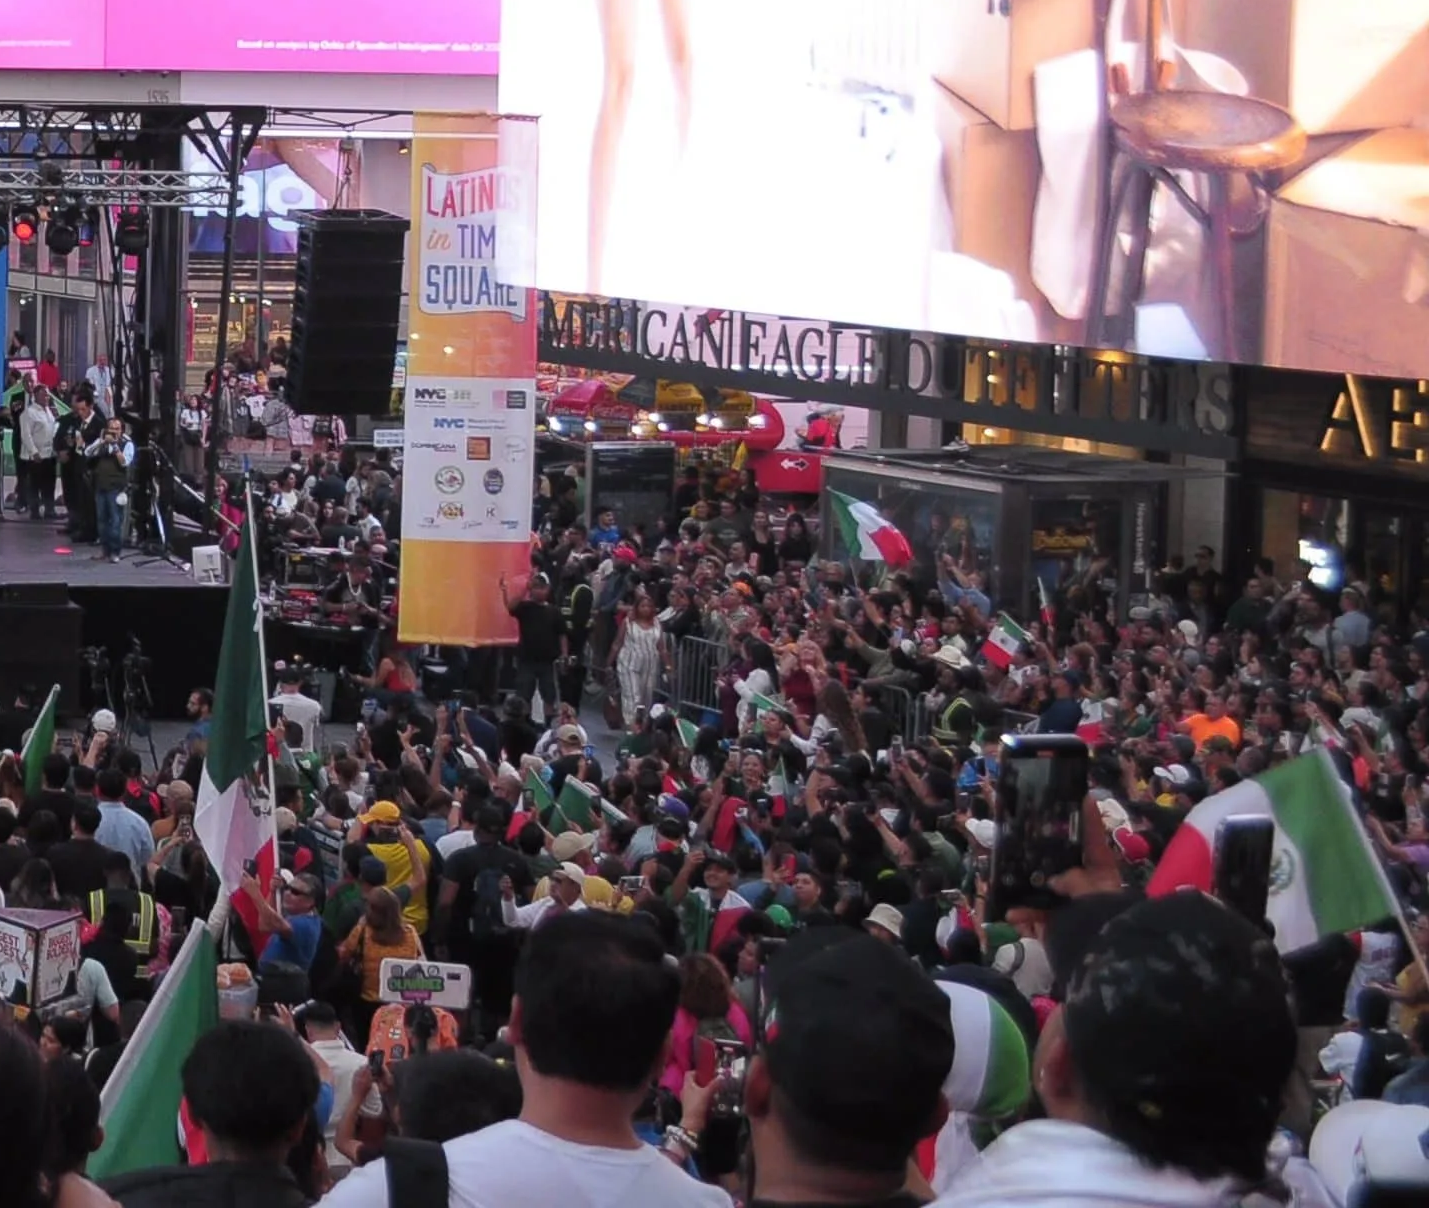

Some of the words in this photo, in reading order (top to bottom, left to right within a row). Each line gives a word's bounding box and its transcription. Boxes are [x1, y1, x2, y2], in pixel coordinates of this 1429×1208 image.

[426, 228, 452, 251] in
[457, 224, 497, 260] TIM
[541, 292, 734, 370] MERICAN
[743, 311, 876, 392] EAGLE
[414, 388, 447, 401] NYC
[433, 416, 466, 429] NYC
